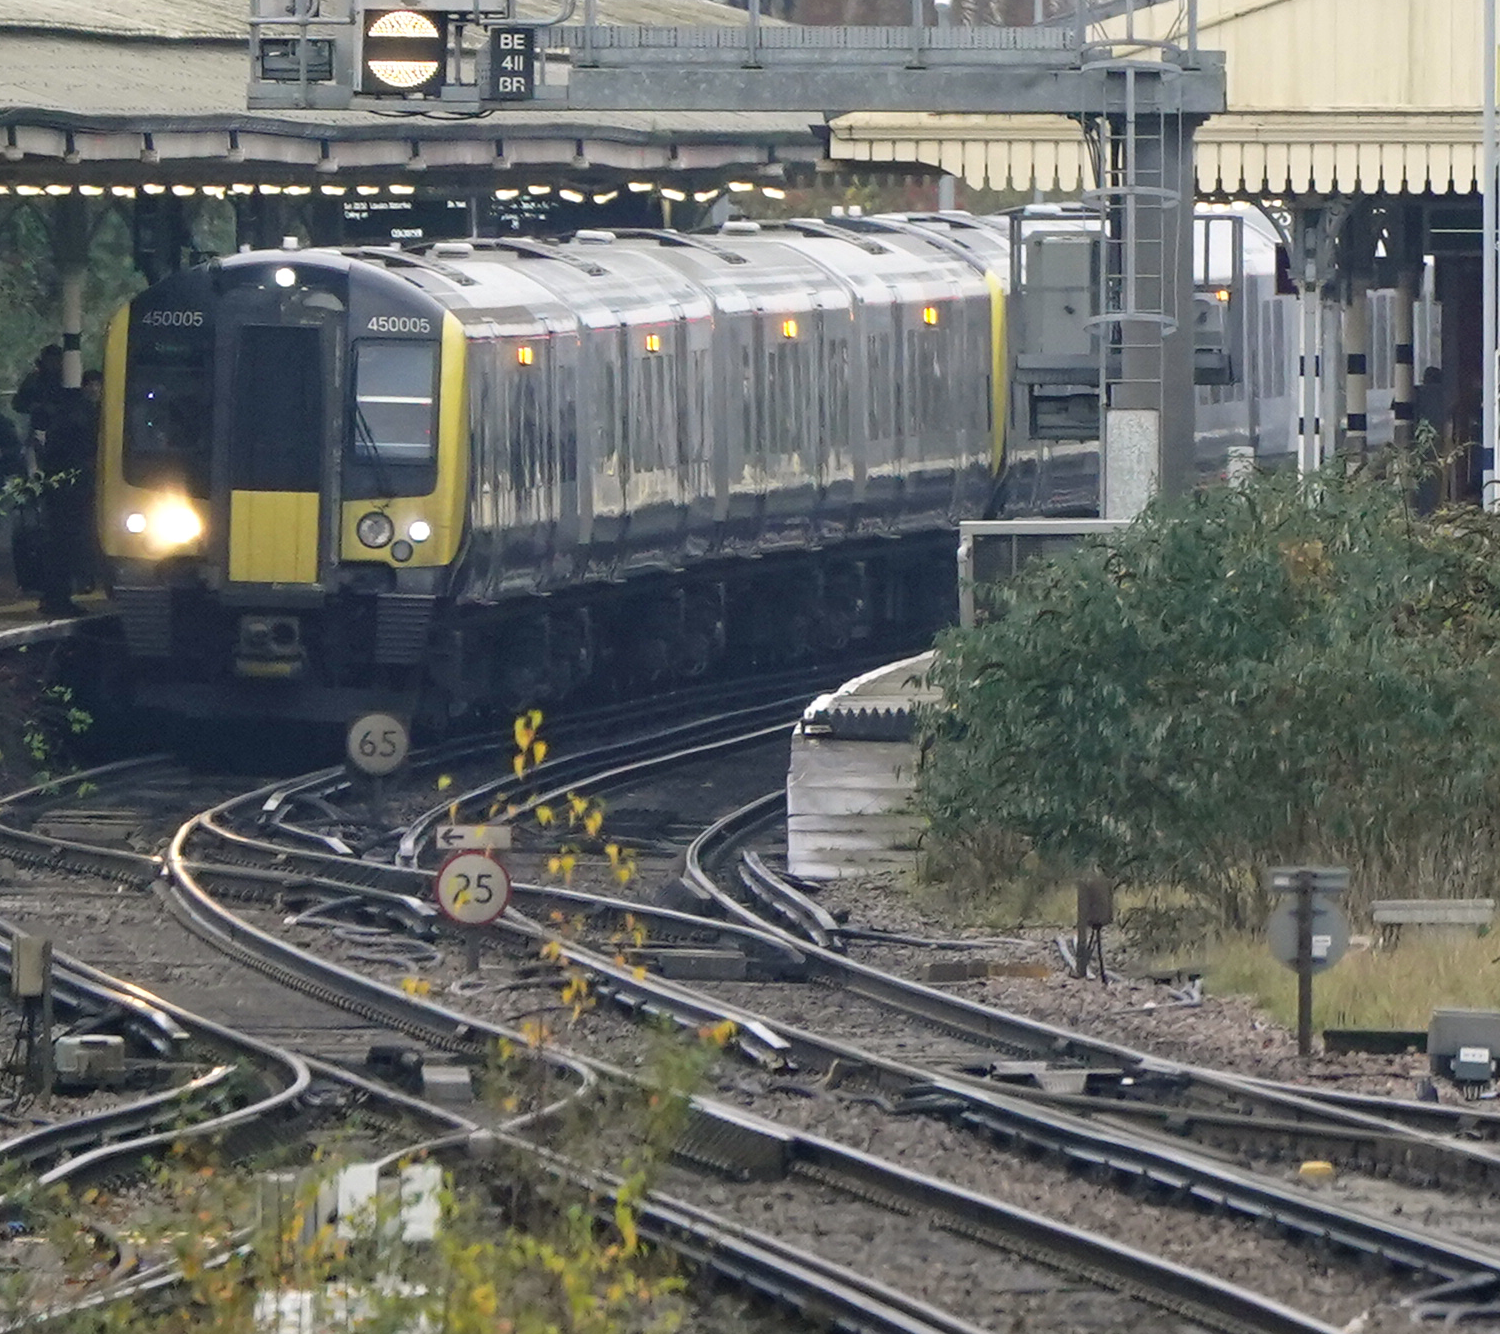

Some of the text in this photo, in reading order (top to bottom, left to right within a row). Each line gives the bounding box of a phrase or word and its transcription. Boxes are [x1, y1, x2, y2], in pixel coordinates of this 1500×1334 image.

[500, 34, 525, 49] BE
[502, 55, 524, 70] 411
[499, 77, 525, 92] BR
[142, 310, 204, 327] 450005
[367, 316, 430, 333] 450005
[359, 730, 397, 757] 65
[453, 873, 493, 904] 25
